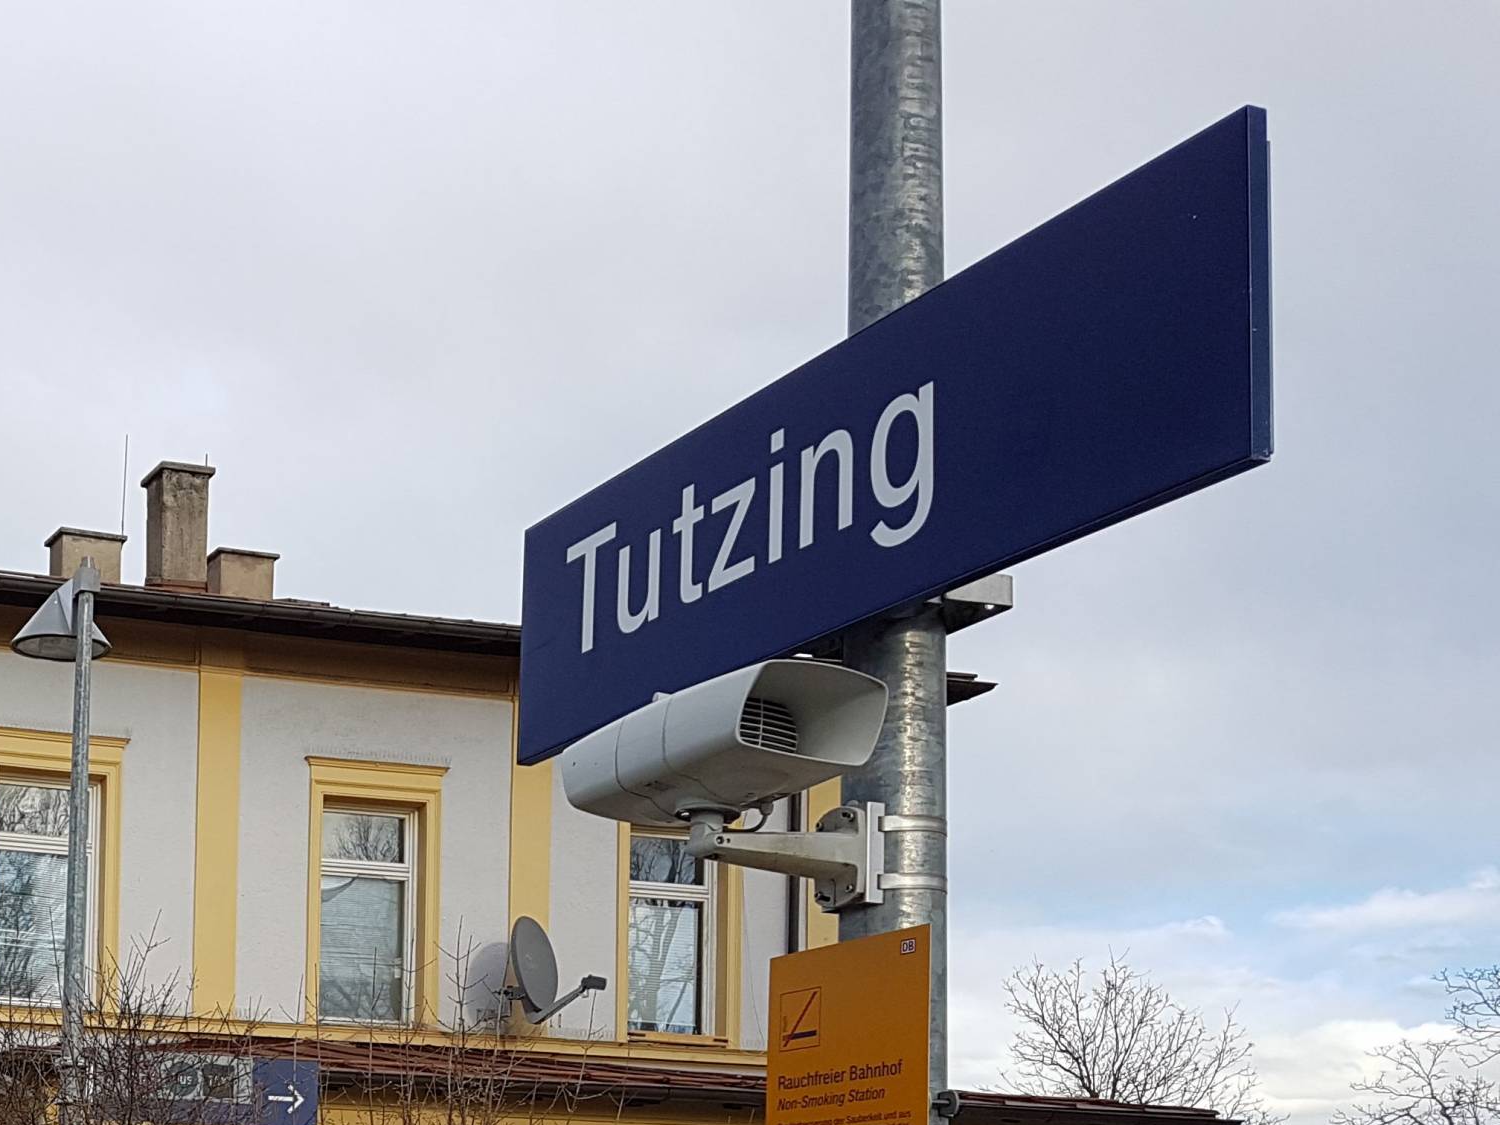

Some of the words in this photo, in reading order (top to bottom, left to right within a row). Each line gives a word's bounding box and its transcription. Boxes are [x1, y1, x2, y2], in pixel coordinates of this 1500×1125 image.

[565, 380, 934, 654] Tutzing
[902, 940, 915, 952] DB
[778, 1068, 847, 1091] Rauchfreier
[849, 1058, 903, 1081] Bahnhof
[777, 1092, 845, 1112] Non-Smoking
[848, 1086, 886, 1103] Station
